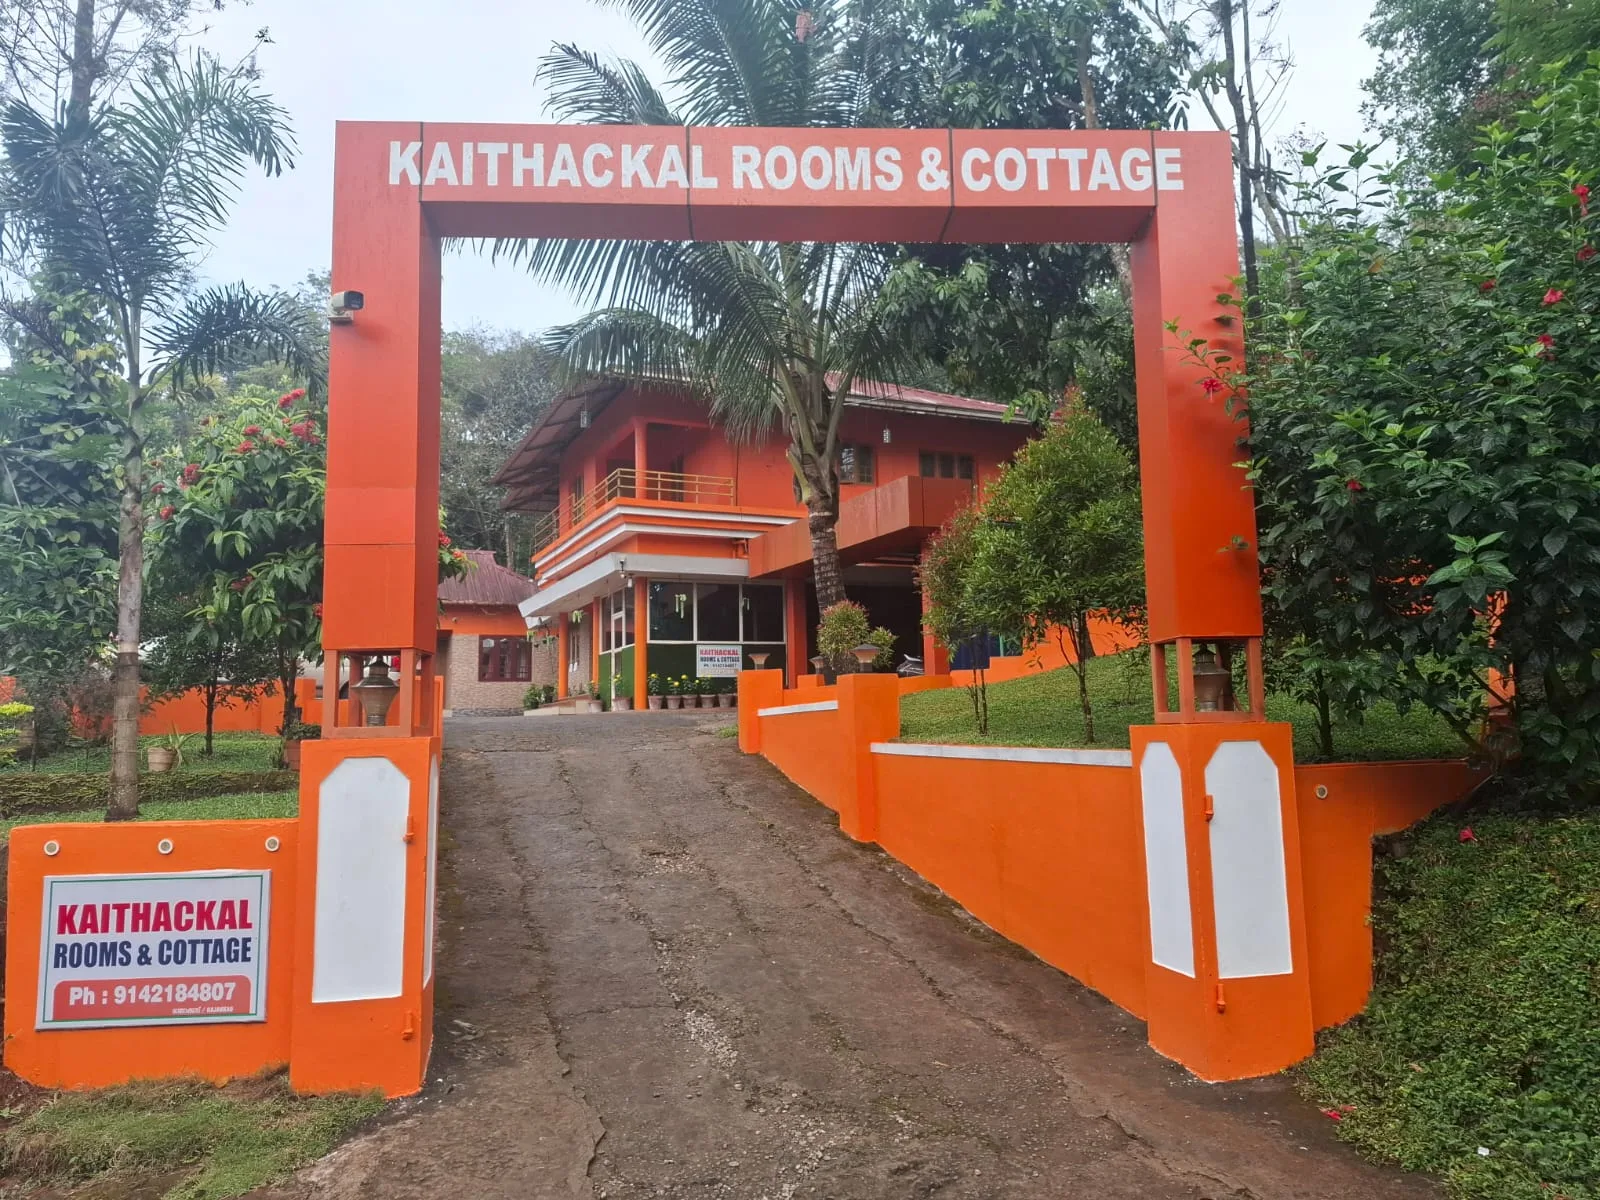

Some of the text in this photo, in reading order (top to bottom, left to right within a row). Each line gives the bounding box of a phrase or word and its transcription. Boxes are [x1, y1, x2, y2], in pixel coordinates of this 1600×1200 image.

[389, 141, 1184, 193] KAITHACKAL ROOMS & COTTAGE
[57, 899, 253, 935] KAITHACKAL
[53, 937, 252, 969] ROOMS & COTTAGE
[69, 986, 95, 1006] Ph
[114, 982, 236, 1005] 9142184807
